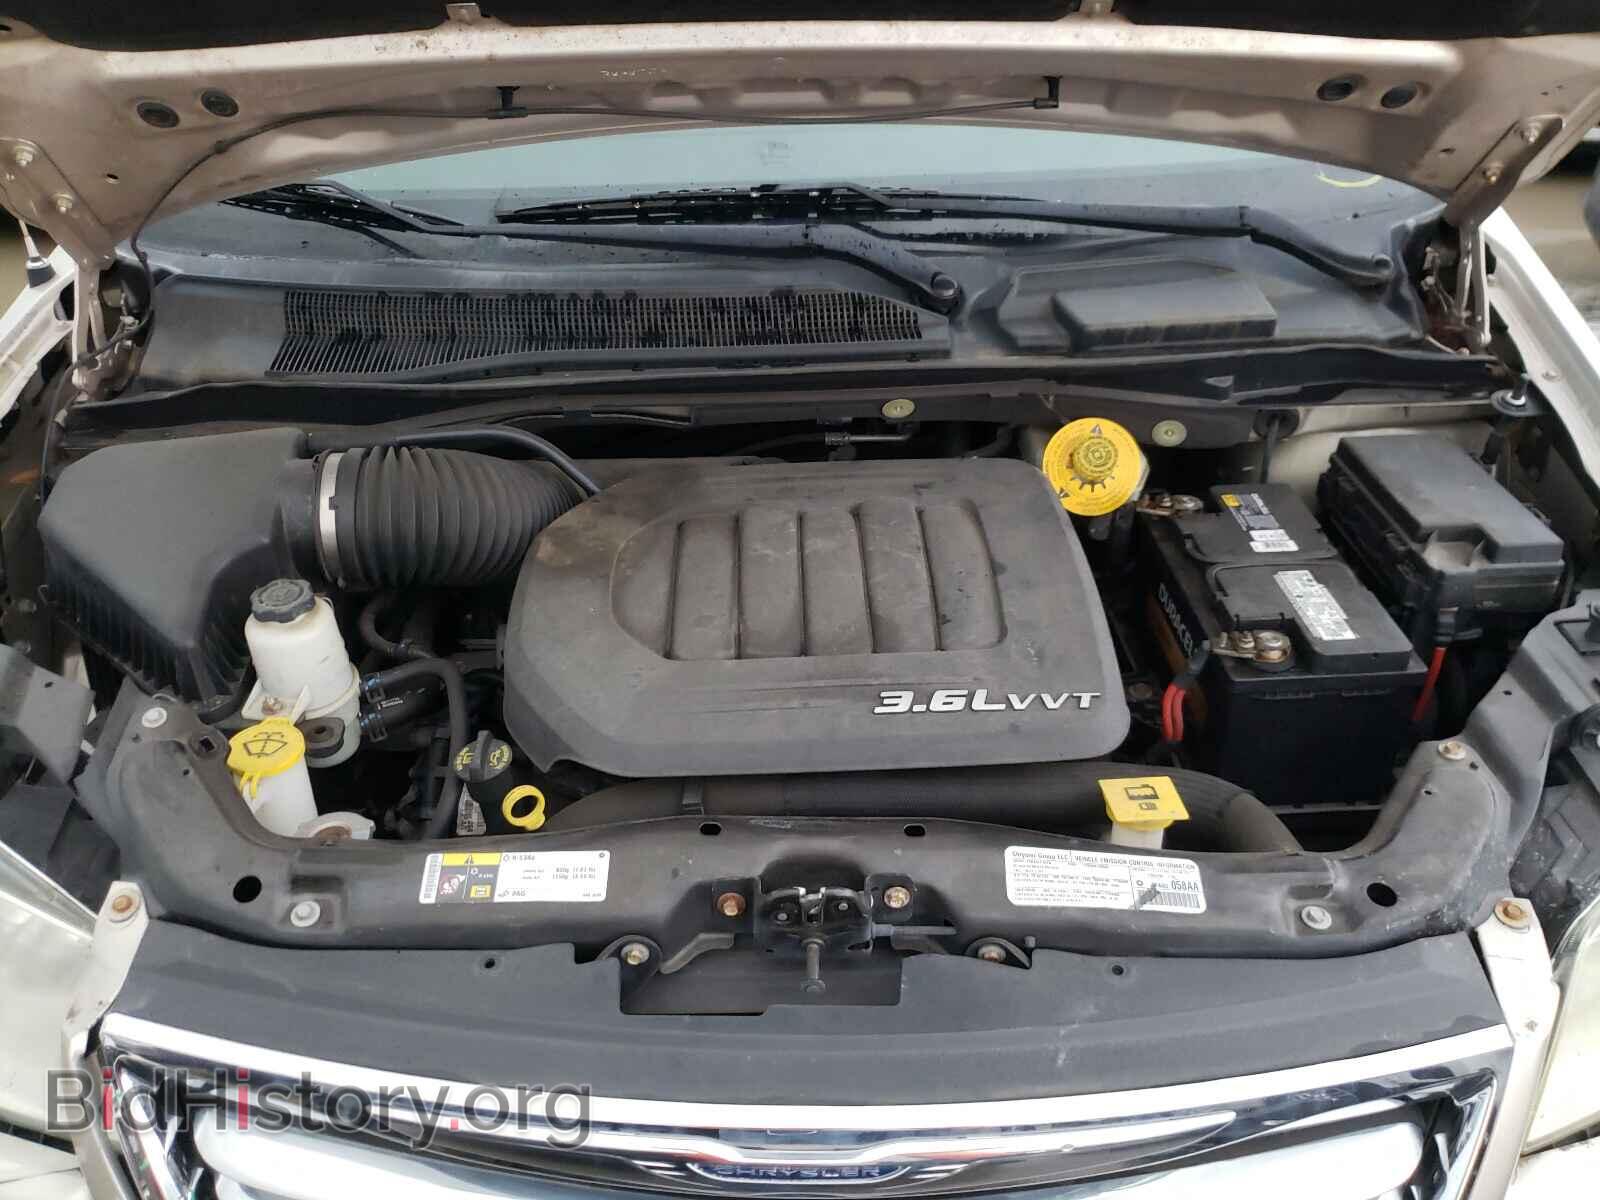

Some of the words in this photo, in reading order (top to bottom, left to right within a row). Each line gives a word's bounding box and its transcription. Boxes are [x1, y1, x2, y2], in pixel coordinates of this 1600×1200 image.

[873, 689, 1006, 714] 3.6L
[1007, 693, 1101, 711] VVT
[717, 1165, 881, 1178] CHRYSLER
